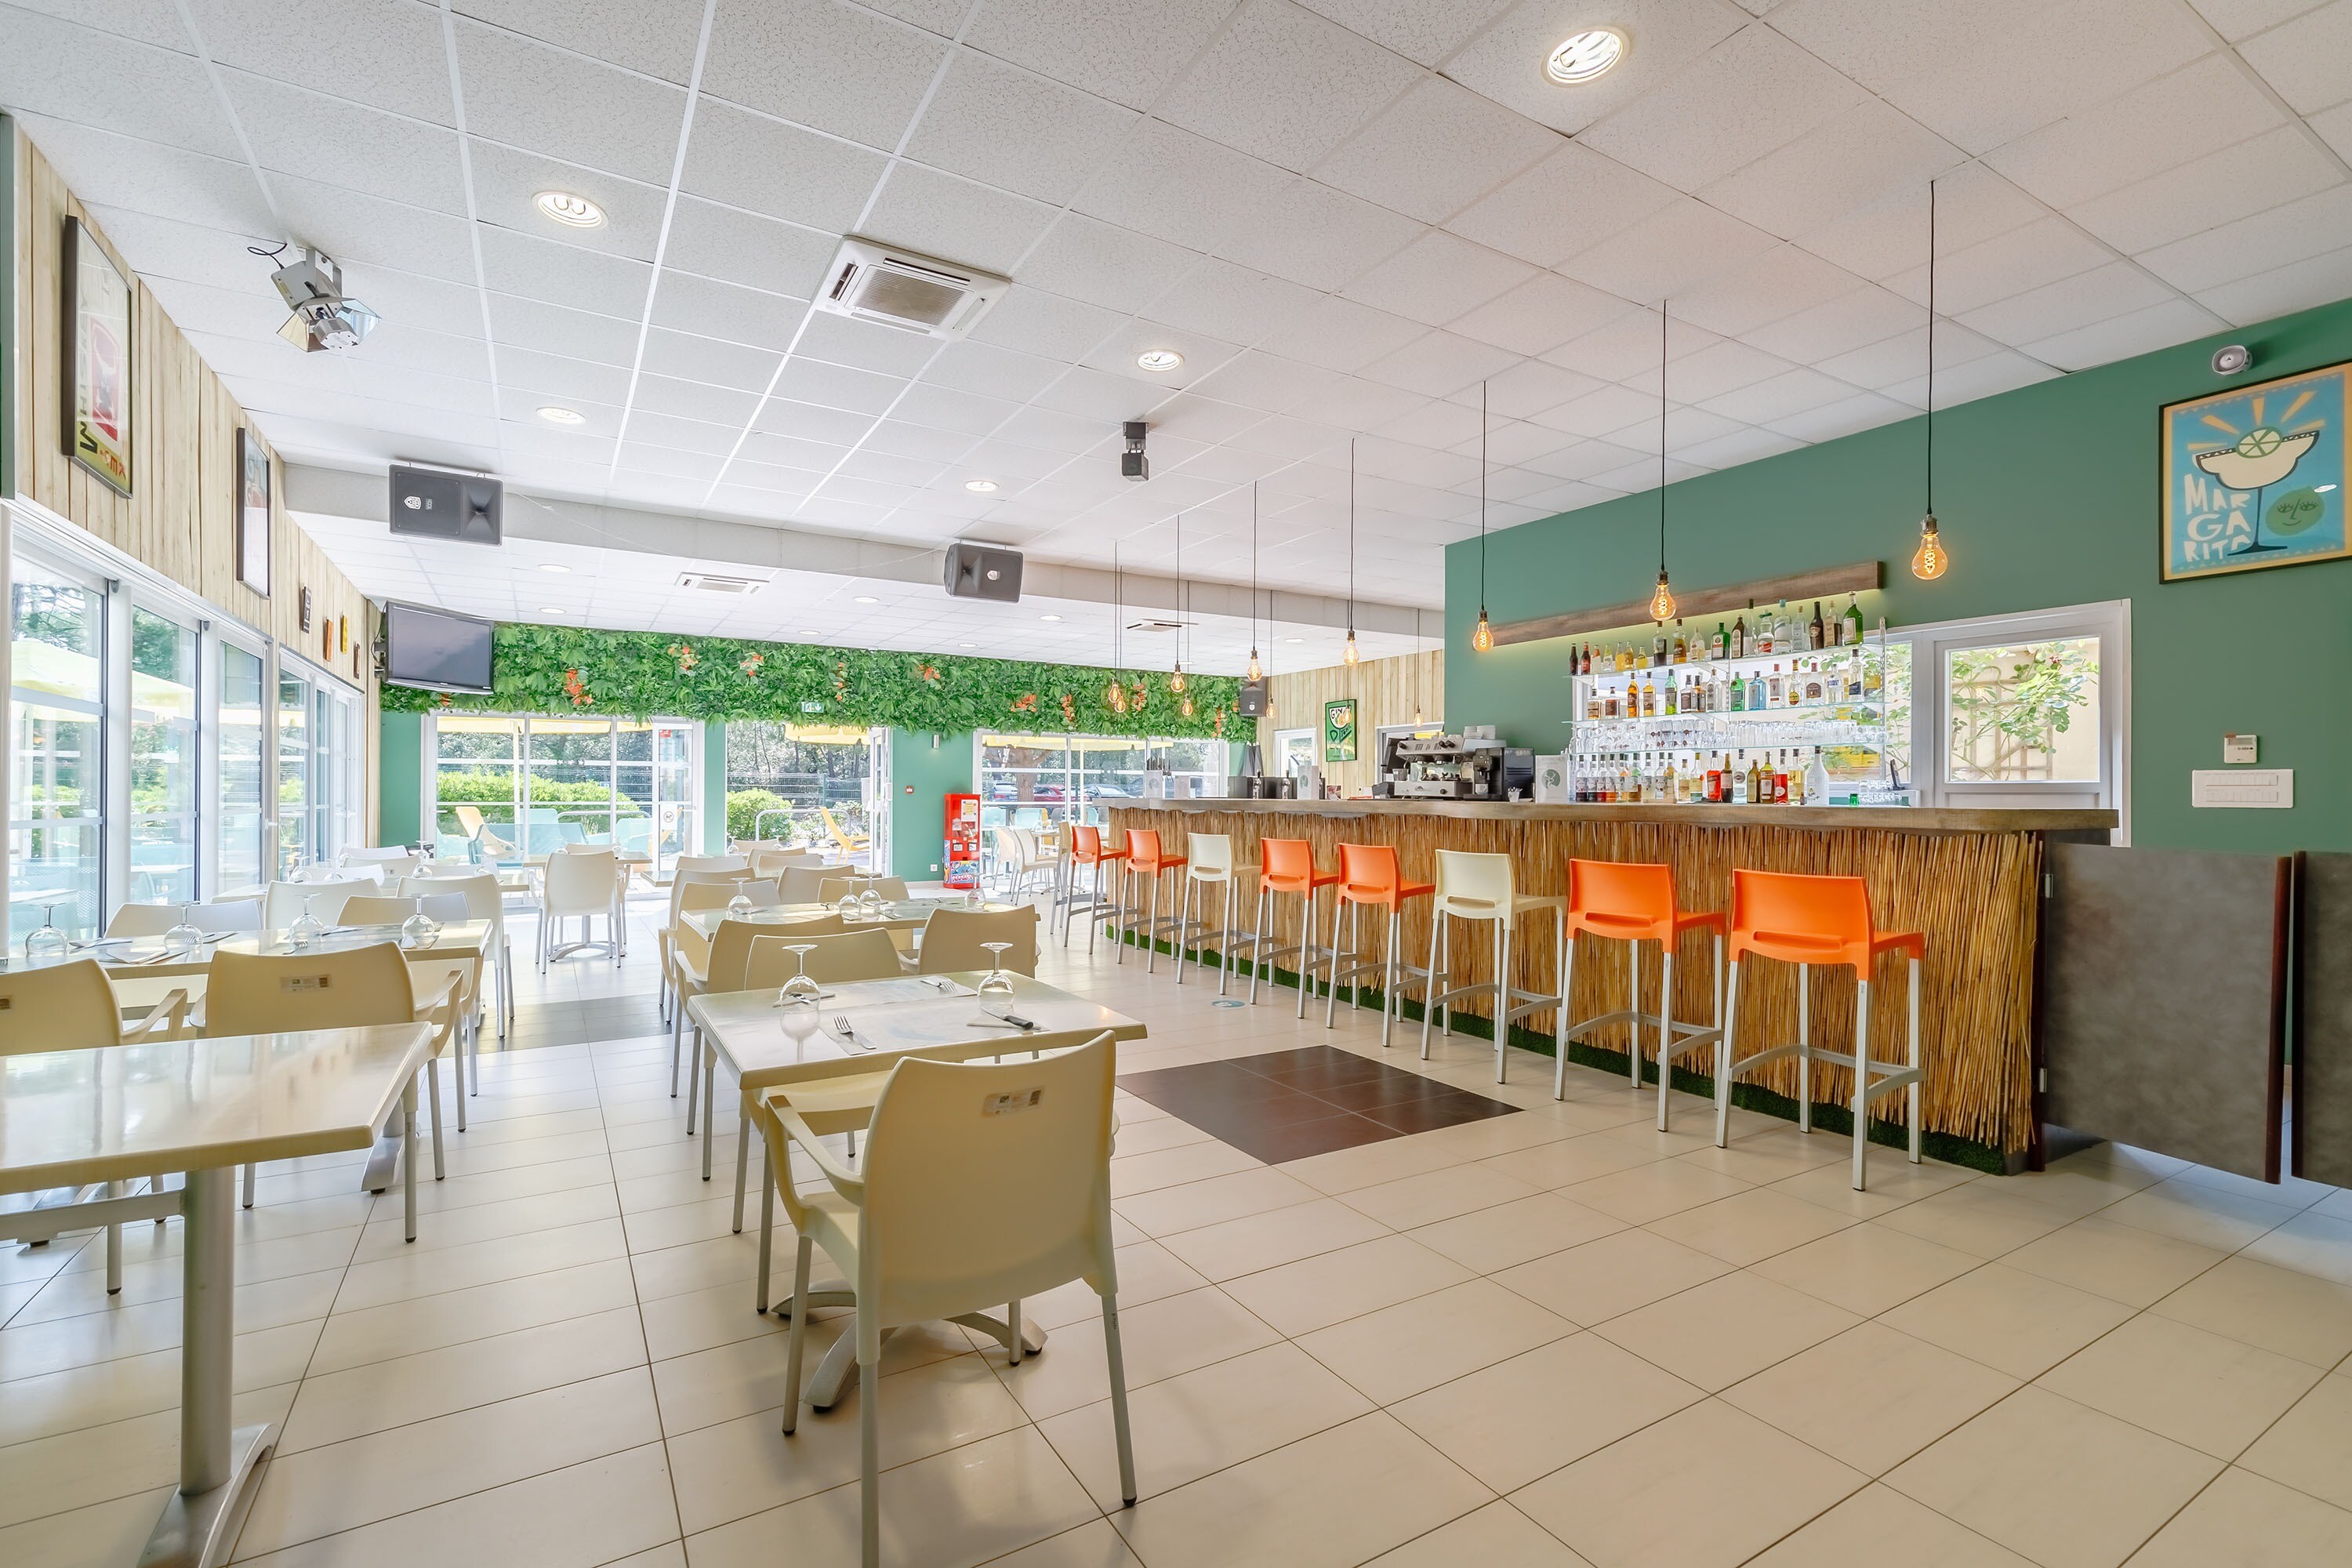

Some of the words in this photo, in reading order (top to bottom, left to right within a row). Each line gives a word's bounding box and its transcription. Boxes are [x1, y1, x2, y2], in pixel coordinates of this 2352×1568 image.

[2184, 474, 2251, 514] MAR
[2187, 510, 2251, 541] GA
[2184, 535, 2251, 562] RITA
[1330, 708, 1343, 719] GIN
